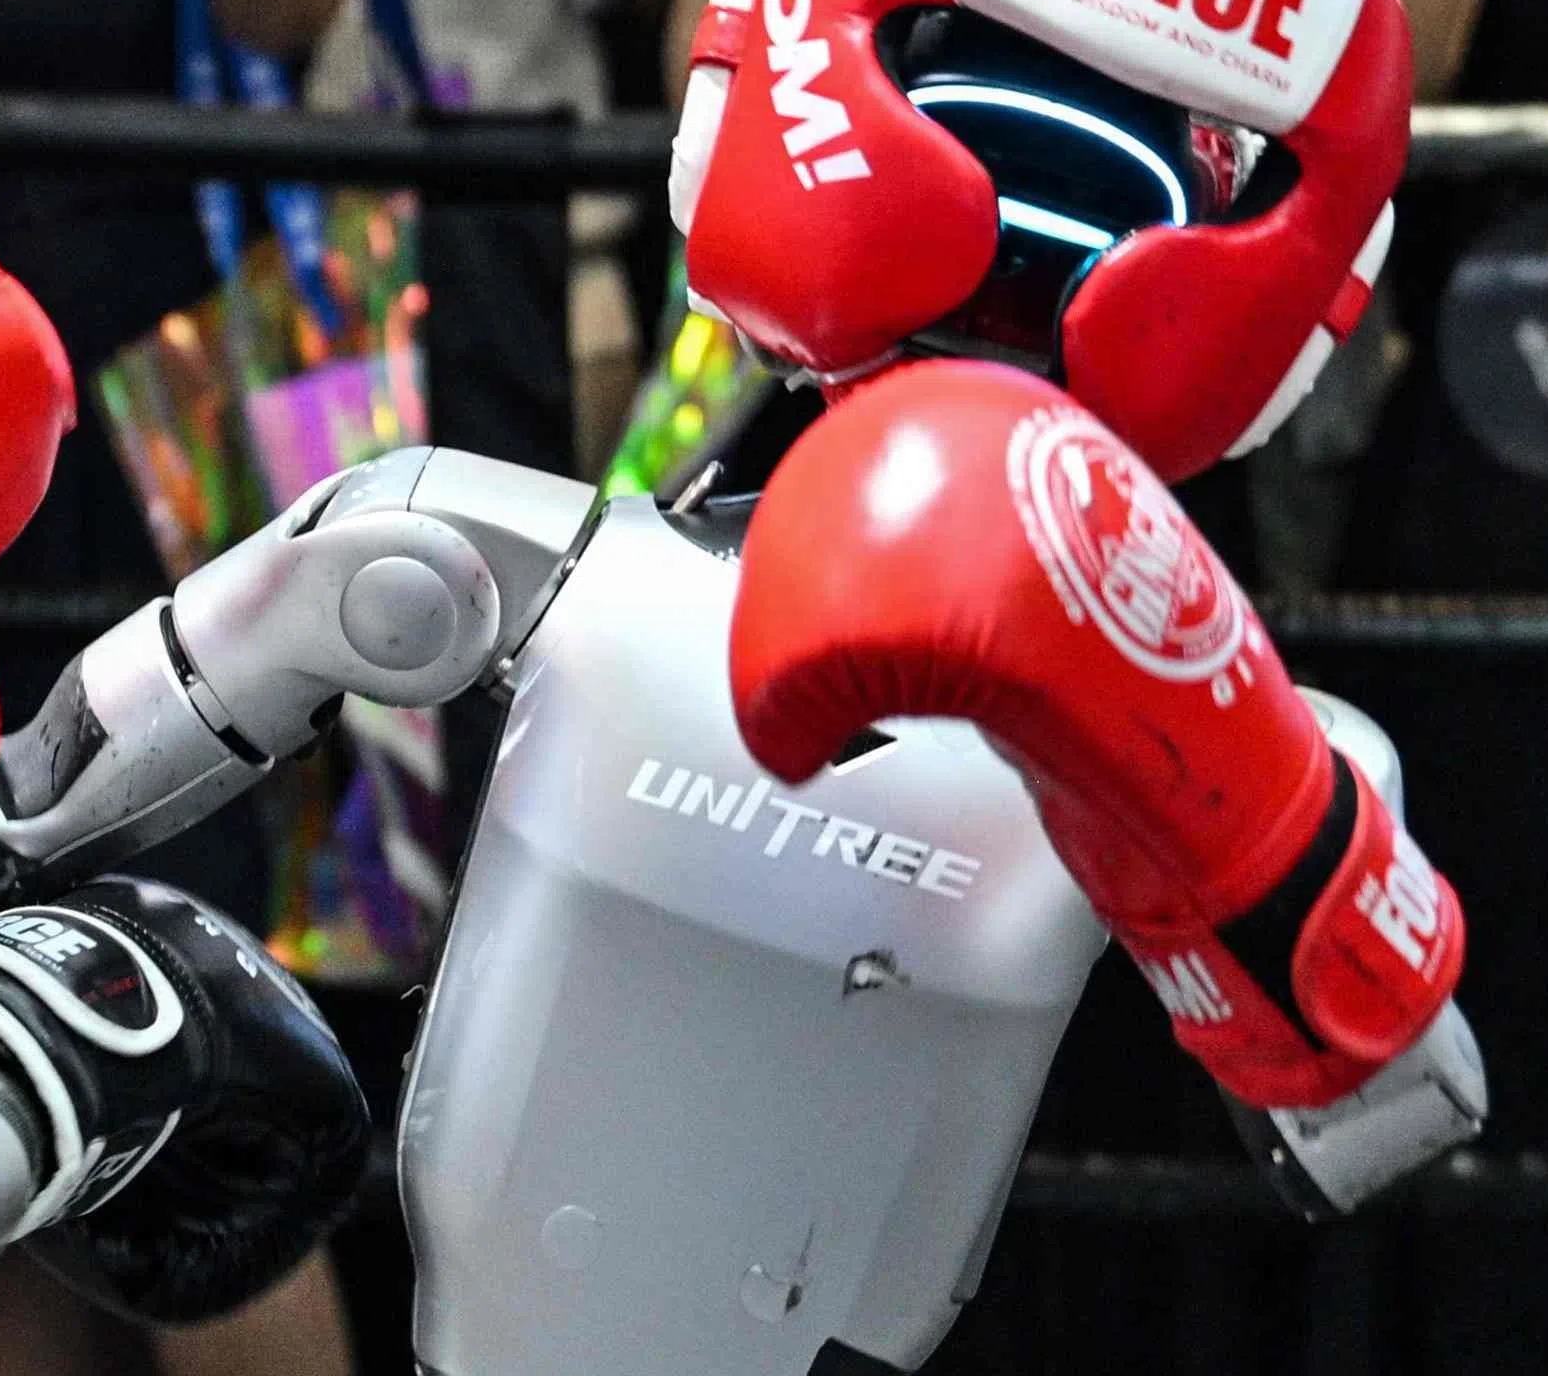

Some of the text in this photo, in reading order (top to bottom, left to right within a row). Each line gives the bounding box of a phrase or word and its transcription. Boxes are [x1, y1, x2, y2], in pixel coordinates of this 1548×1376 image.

[1166, 25, 1216, 58] AND
[1218, 47, 1293, 94] CHARM
[625, 757, 983, 900] UNITREE
